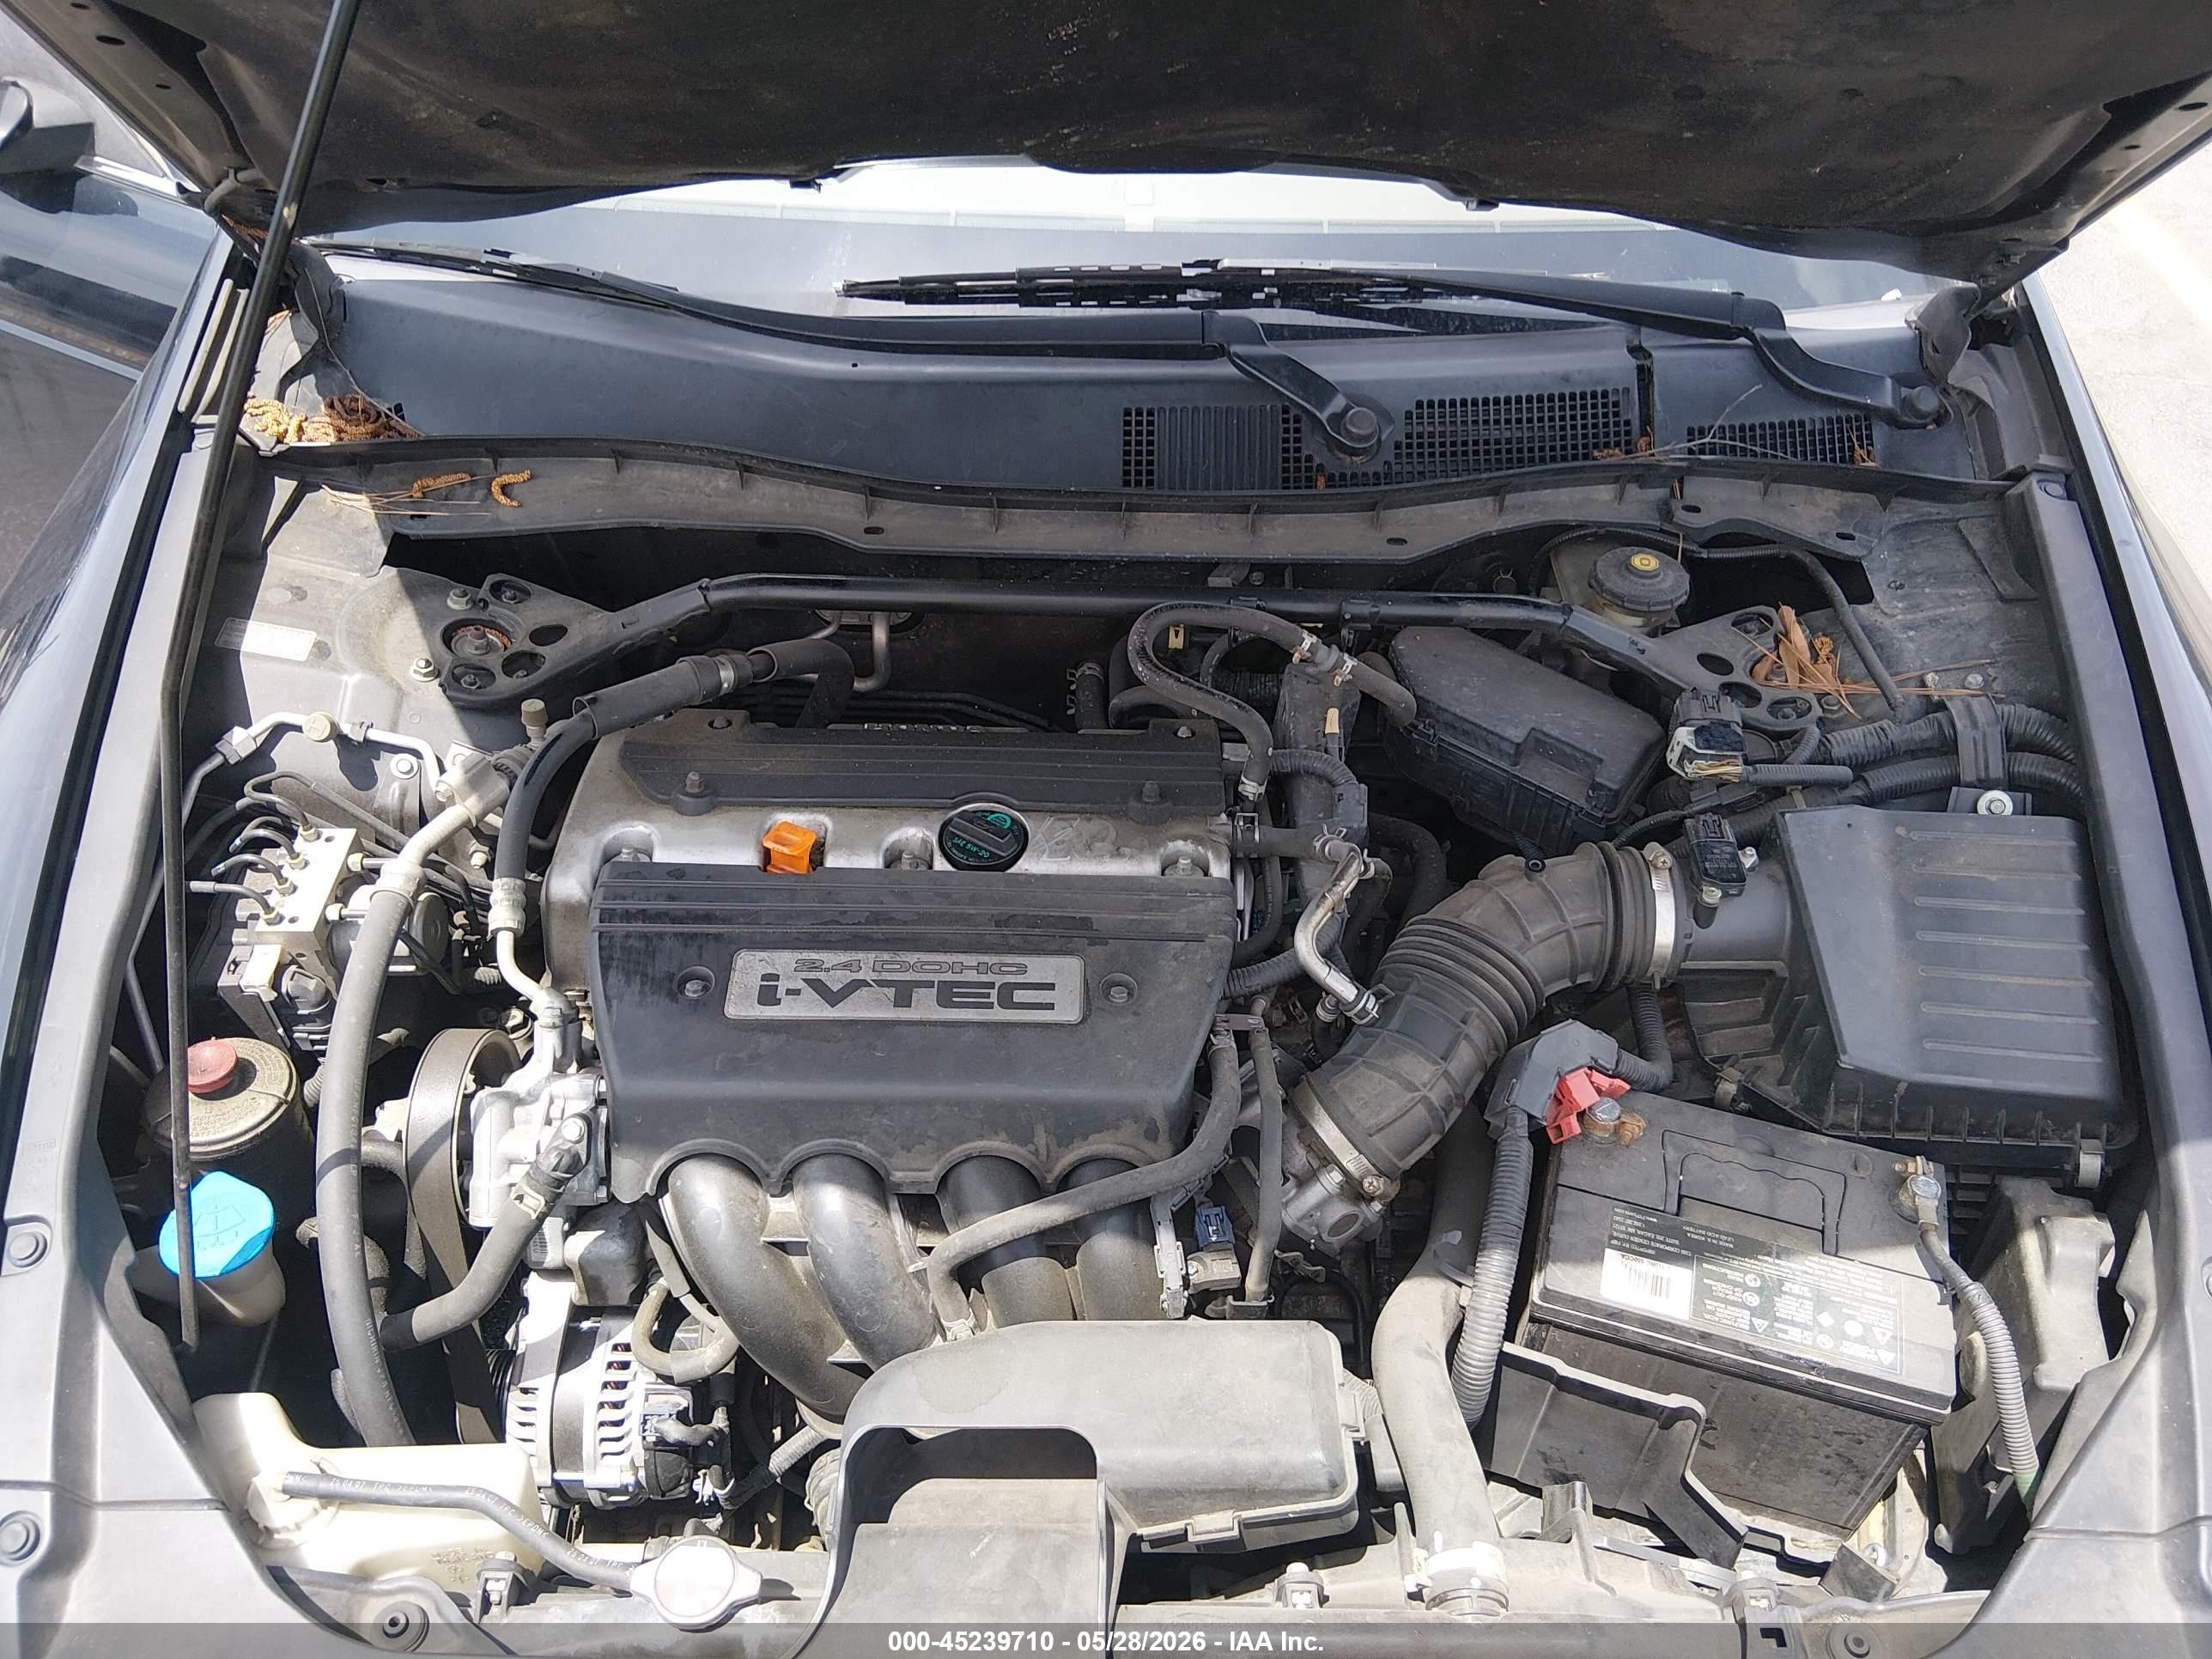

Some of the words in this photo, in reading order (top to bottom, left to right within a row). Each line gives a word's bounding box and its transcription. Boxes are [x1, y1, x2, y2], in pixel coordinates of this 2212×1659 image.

[953, 836, 966, 848] SAE
[965, 843, 990, 858] 5W-20
[793, 958, 861, 974] 2.4
[872, 960, 1028, 975] DOHC
[757, 972, 1055, 1011] i-VTEC
[1682, 1224, 1705, 1234] BATTERY
[1630, 1235, 1650, 1244] CENTER
[1686, 1231, 1705, 1240] KOREA
[1719, 1234, 1734, 1243] LEAD
[1650, 1241, 1680, 1253] CORPORATE
[1718, 1240, 1734, 1249] MADE
[501, 1504, 516, 1516] TPC
